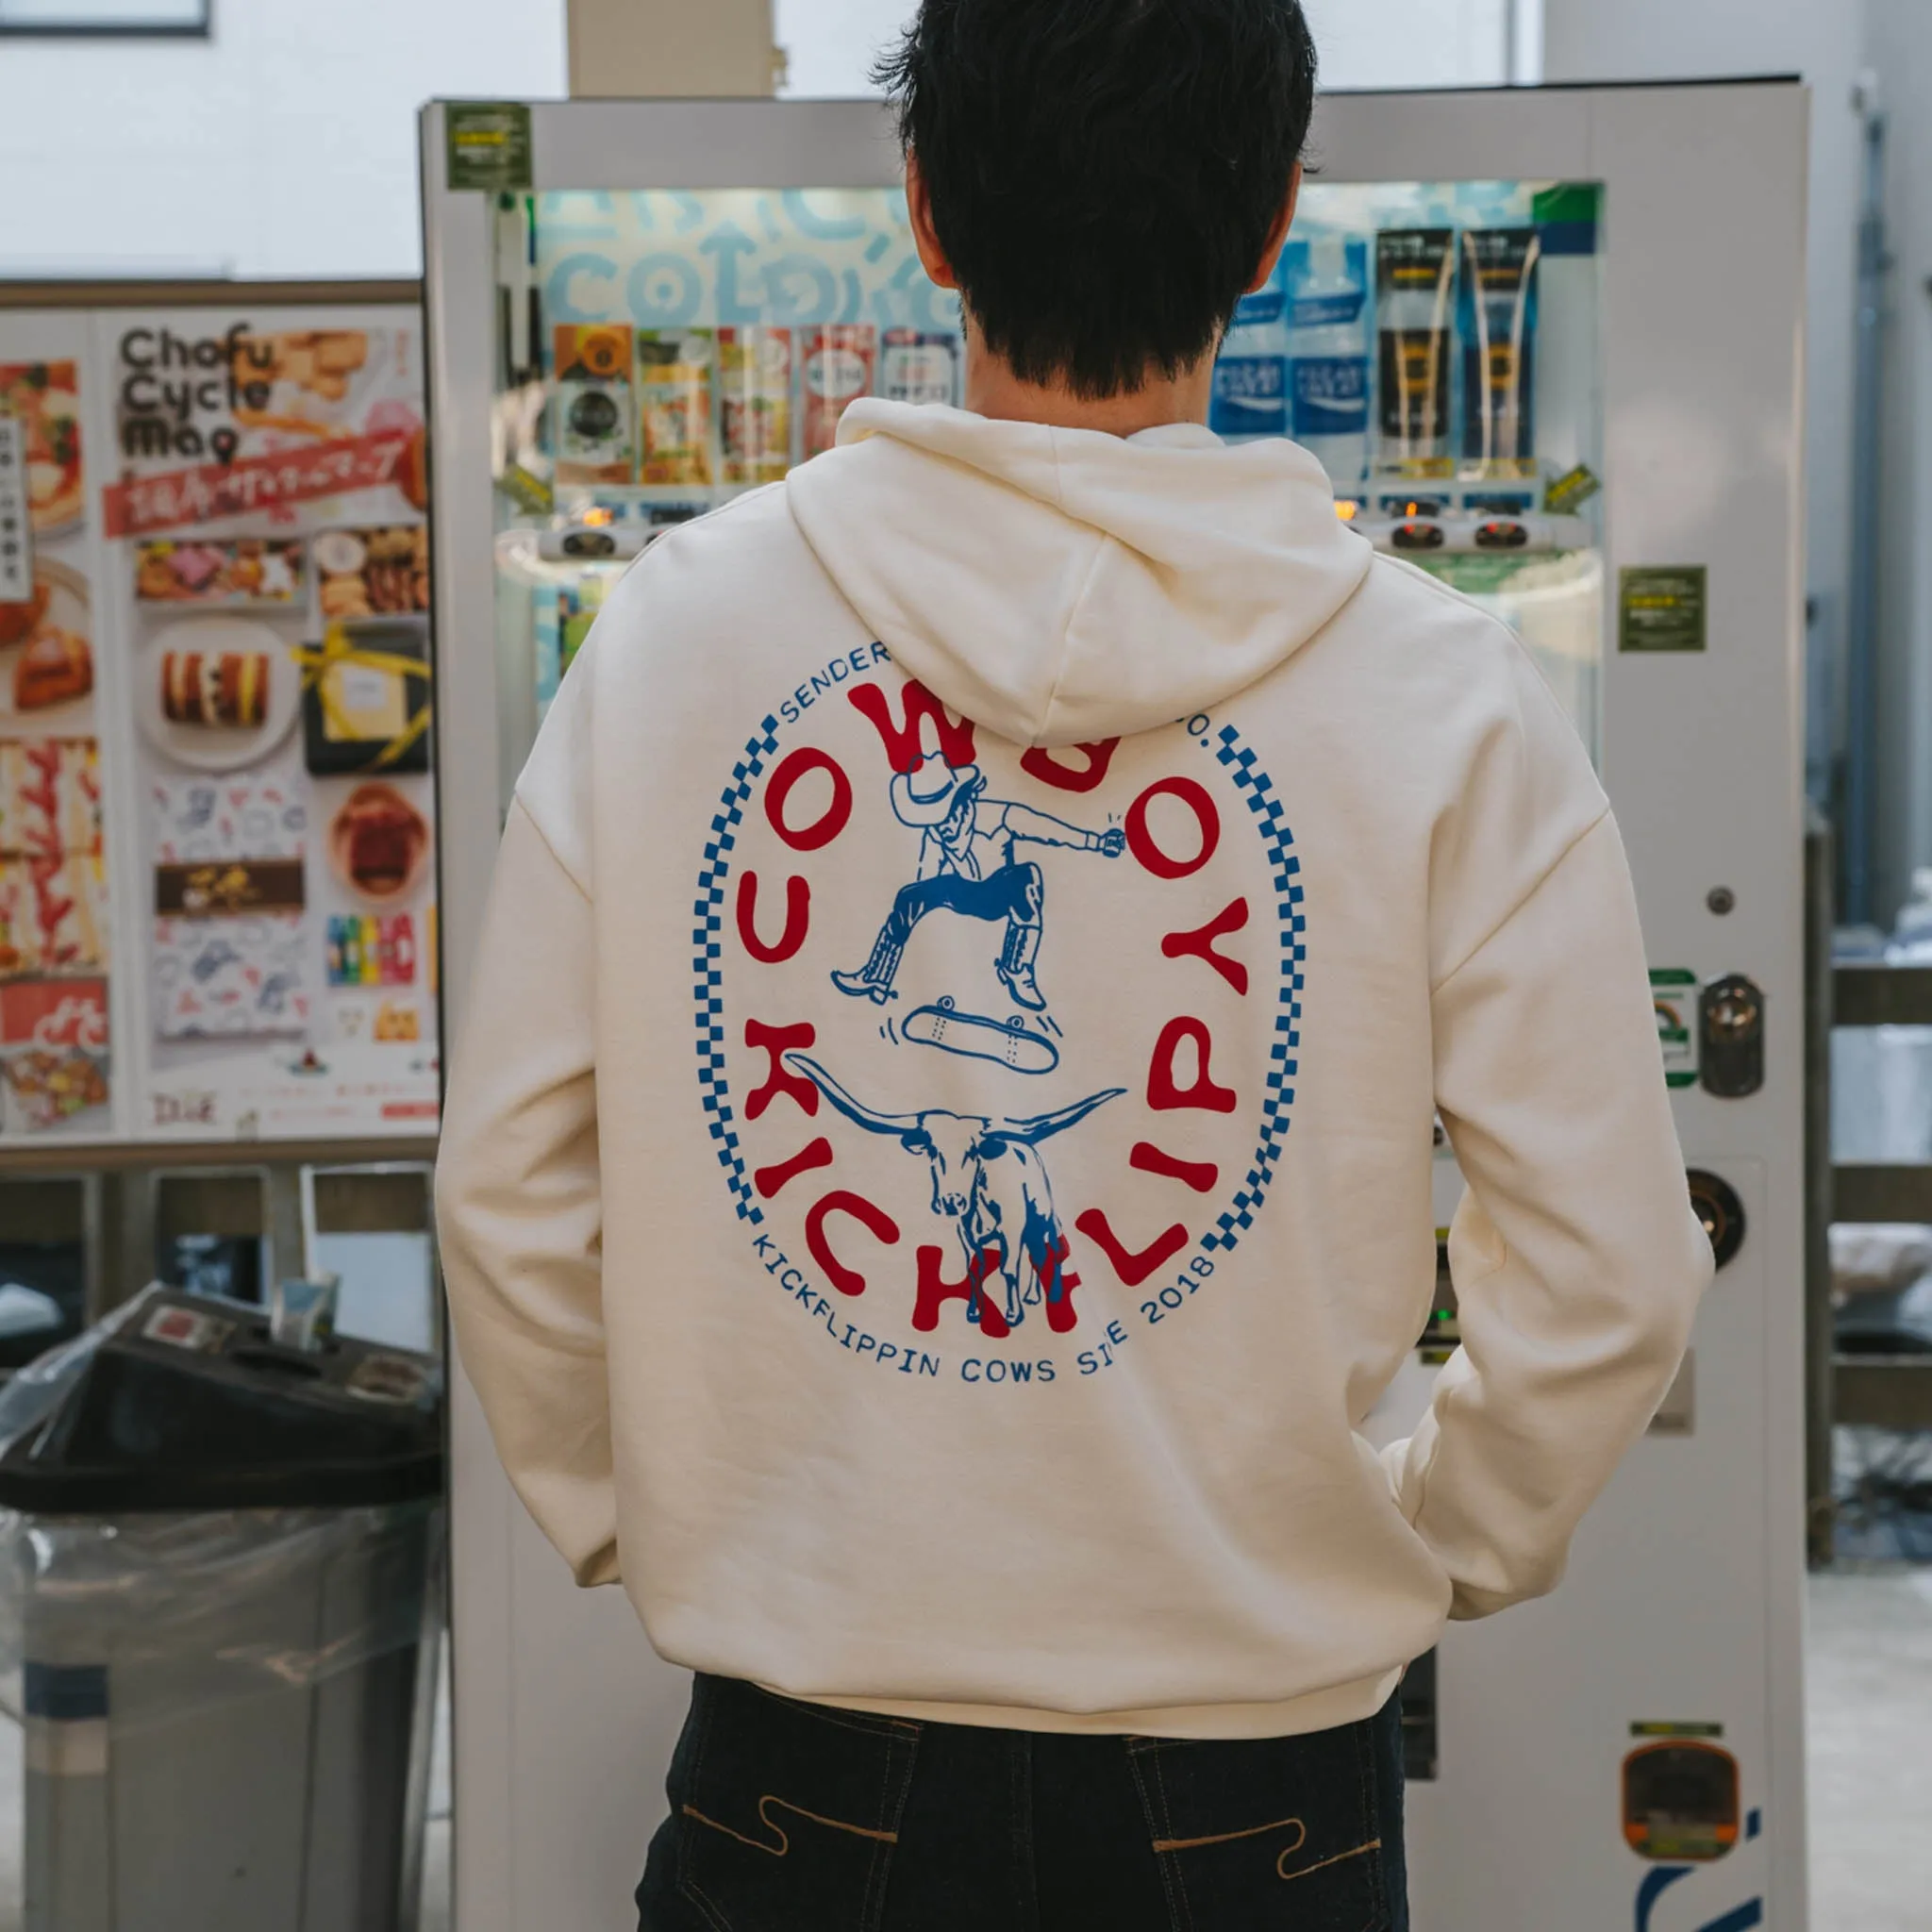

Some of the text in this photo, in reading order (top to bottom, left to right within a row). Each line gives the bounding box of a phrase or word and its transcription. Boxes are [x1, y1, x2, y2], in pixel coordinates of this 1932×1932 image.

[120, 319, 274, 369] Chofu
[122, 372, 272, 422] Cycle
[779, 641, 892, 724] SENDER
[752, 1233, 940, 1378] KICKFLIPPIN
[960, 1358, 1057, 1383] COWS
[1140, 1256, 1215, 1324] 2018
